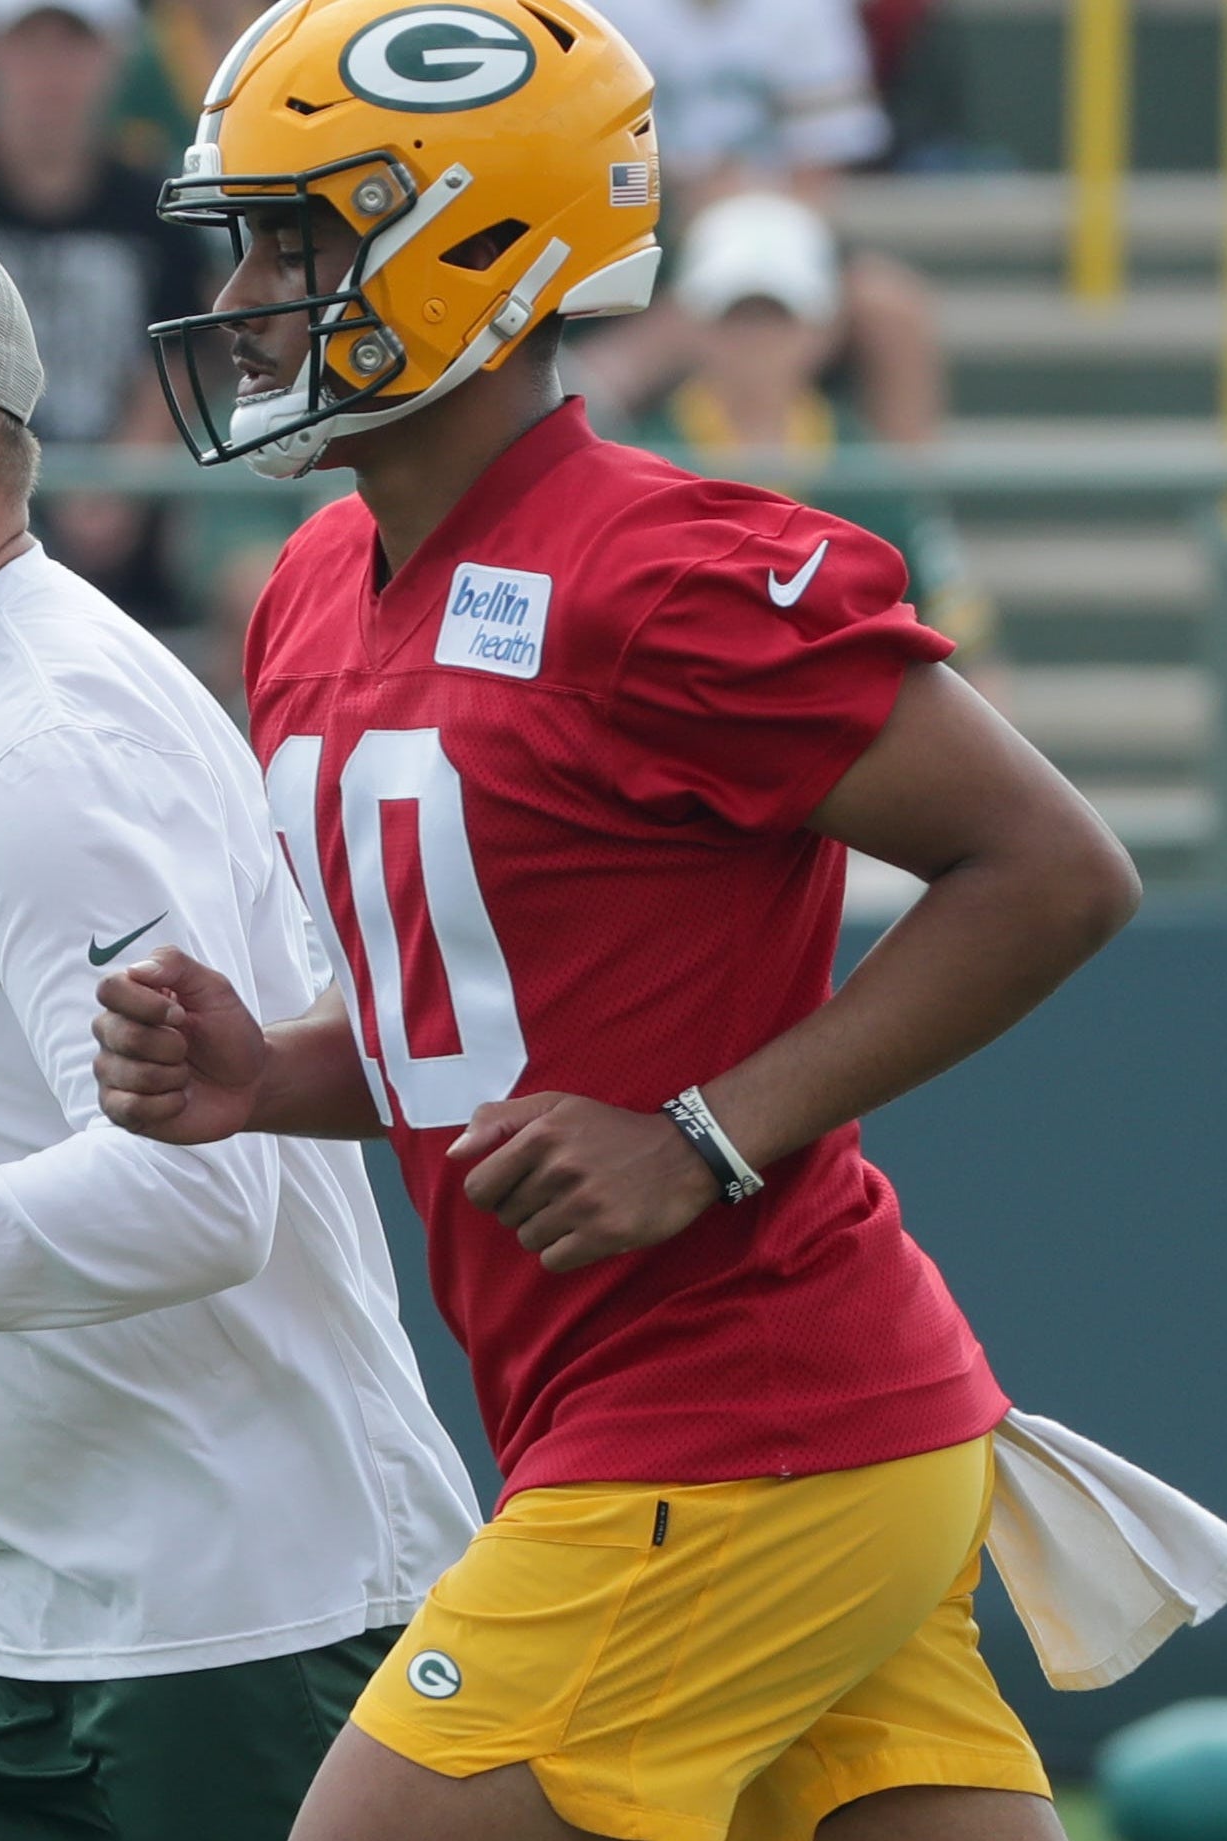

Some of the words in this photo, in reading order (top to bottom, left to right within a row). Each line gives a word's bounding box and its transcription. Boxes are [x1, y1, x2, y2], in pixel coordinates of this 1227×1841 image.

[347, 9, 529, 104] G
[451, 576, 530, 626] bellin
[468, 624, 537, 666] health
[266, 727, 528, 1129] 10
[408, 1650, 462, 1699] G
